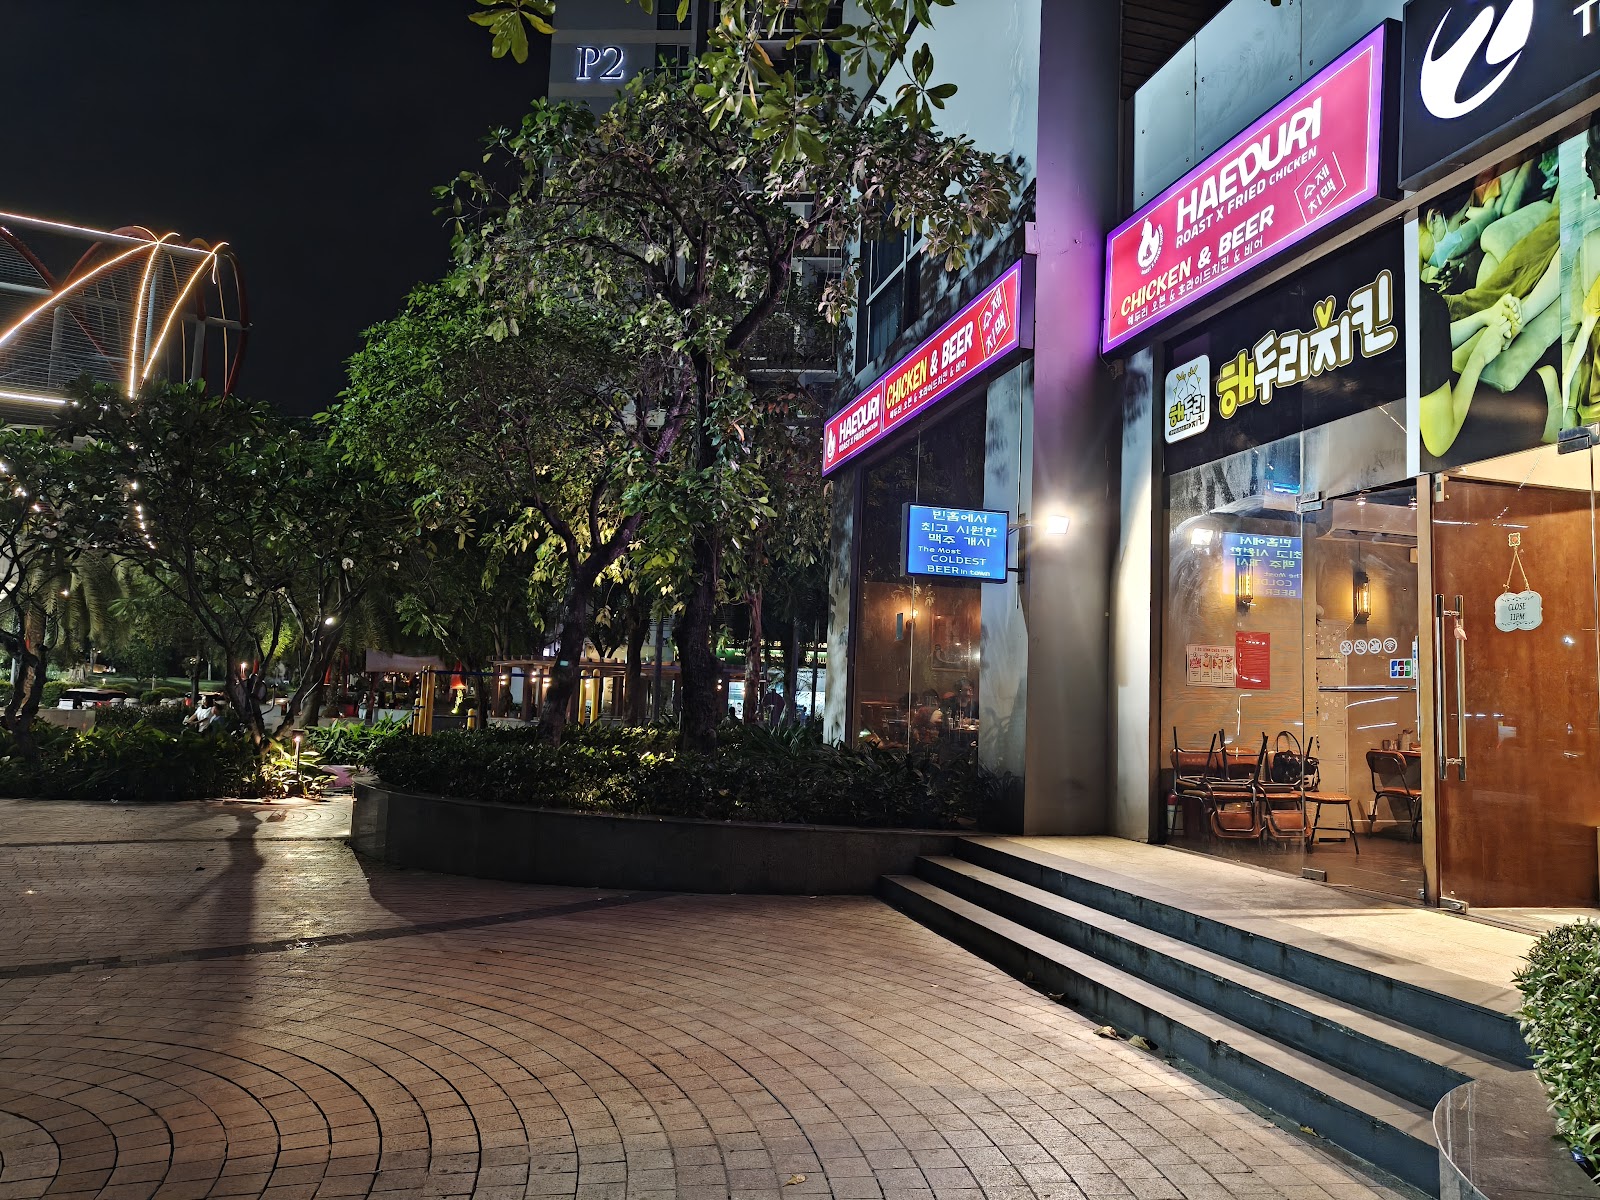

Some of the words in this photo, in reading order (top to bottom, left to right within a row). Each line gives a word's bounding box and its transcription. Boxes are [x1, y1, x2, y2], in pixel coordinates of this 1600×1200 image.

[576, 46, 624, 80] P2
[1176, 96, 1322, 233] HAEDURI
[1304, 164, 1330, 200] 수제
[1176, 213, 1213, 249] ROAST
[1216, 206, 1224, 223] X
[1227, 178, 1266, 214] FRIED
[1269, 145, 1317, 186] CHICKEN
[1308, 178, 1336, 215] 치맥
[1120, 256, 1192, 317] CHICKEN
[1197, 245, 1212, 269] &
[1218, 204, 1275, 258] BEER
[1169, 288, 1175, 301] &
[1178, 255, 1229, 295] 후라이드치킨
[1233, 249, 1240, 263] &
[1244, 235, 1263, 256] 비어
[984, 287, 1003, 331] 수제
[986, 309, 1006, 354] 치맥
[1216, 270, 1397, 418] 해두리치킨
[886, 356, 928, 410] CHICKEN
[930, 349, 938, 377] &
[941, 320, 974, 370] BEER
[839, 393, 880, 444] HAEDURI
[1168, 393, 1206, 428] 해두리
[921, 521, 949, 533] 최고
[956, 525, 998, 537] 시원한
[932, 510, 988, 524] 빈홈에서
[918, 545, 935, 553] The
[937, 547, 962, 555] Most
[928, 533, 956, 545] 맥주
[963, 536, 990, 547] 개시
[927, 564, 959, 574] BEER
[970, 569, 991, 577] town
[931, 554, 987, 566] COLDEST
[1507, 603, 1526, 611] CLOSE
[1510, 613, 1525, 621] 11PM
